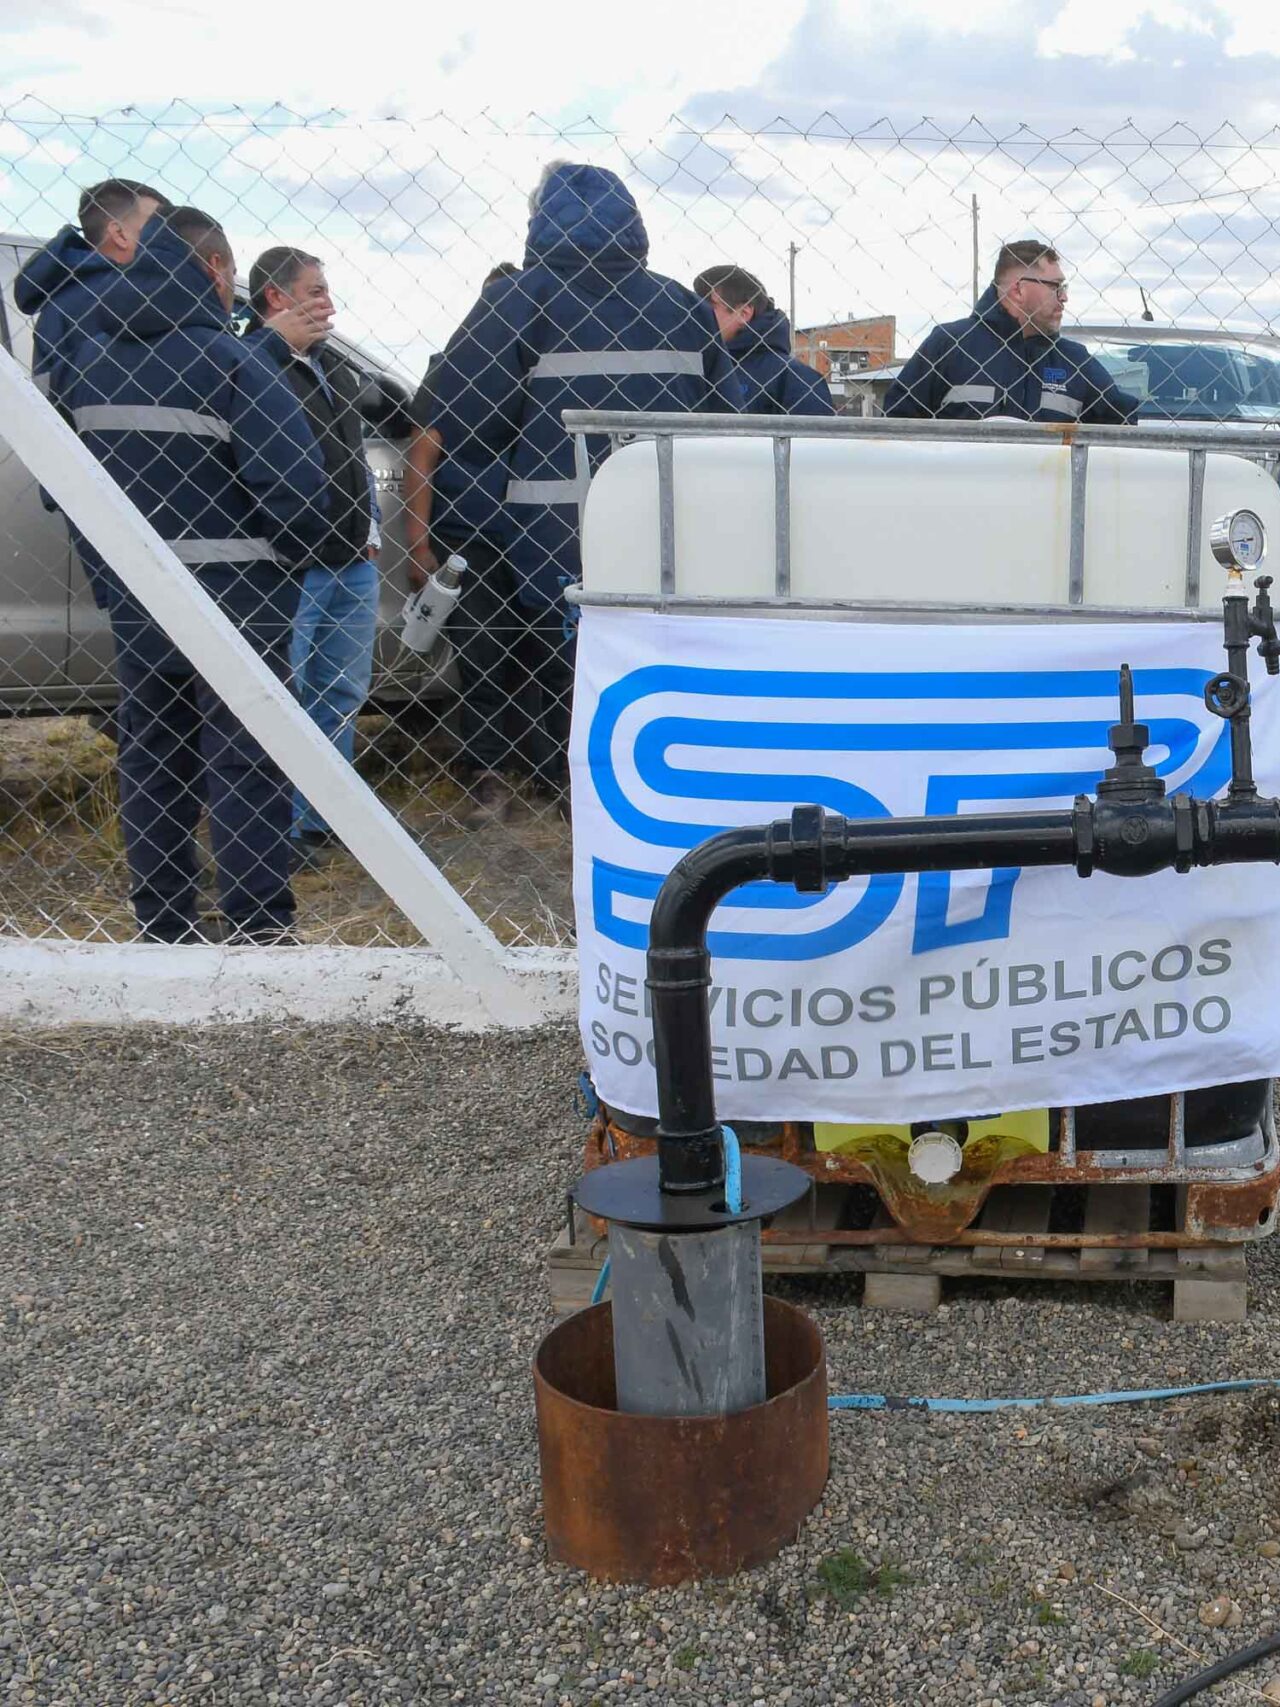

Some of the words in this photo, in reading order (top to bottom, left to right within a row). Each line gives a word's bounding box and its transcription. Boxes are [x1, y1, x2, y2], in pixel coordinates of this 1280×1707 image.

[919, 938, 1232, 1015] PÚBLICOS
[591, 1020, 859, 1082] SOEDAD
[880, 1033, 992, 1078] DEL
[1011, 995, 1232, 1065] ESTADO
